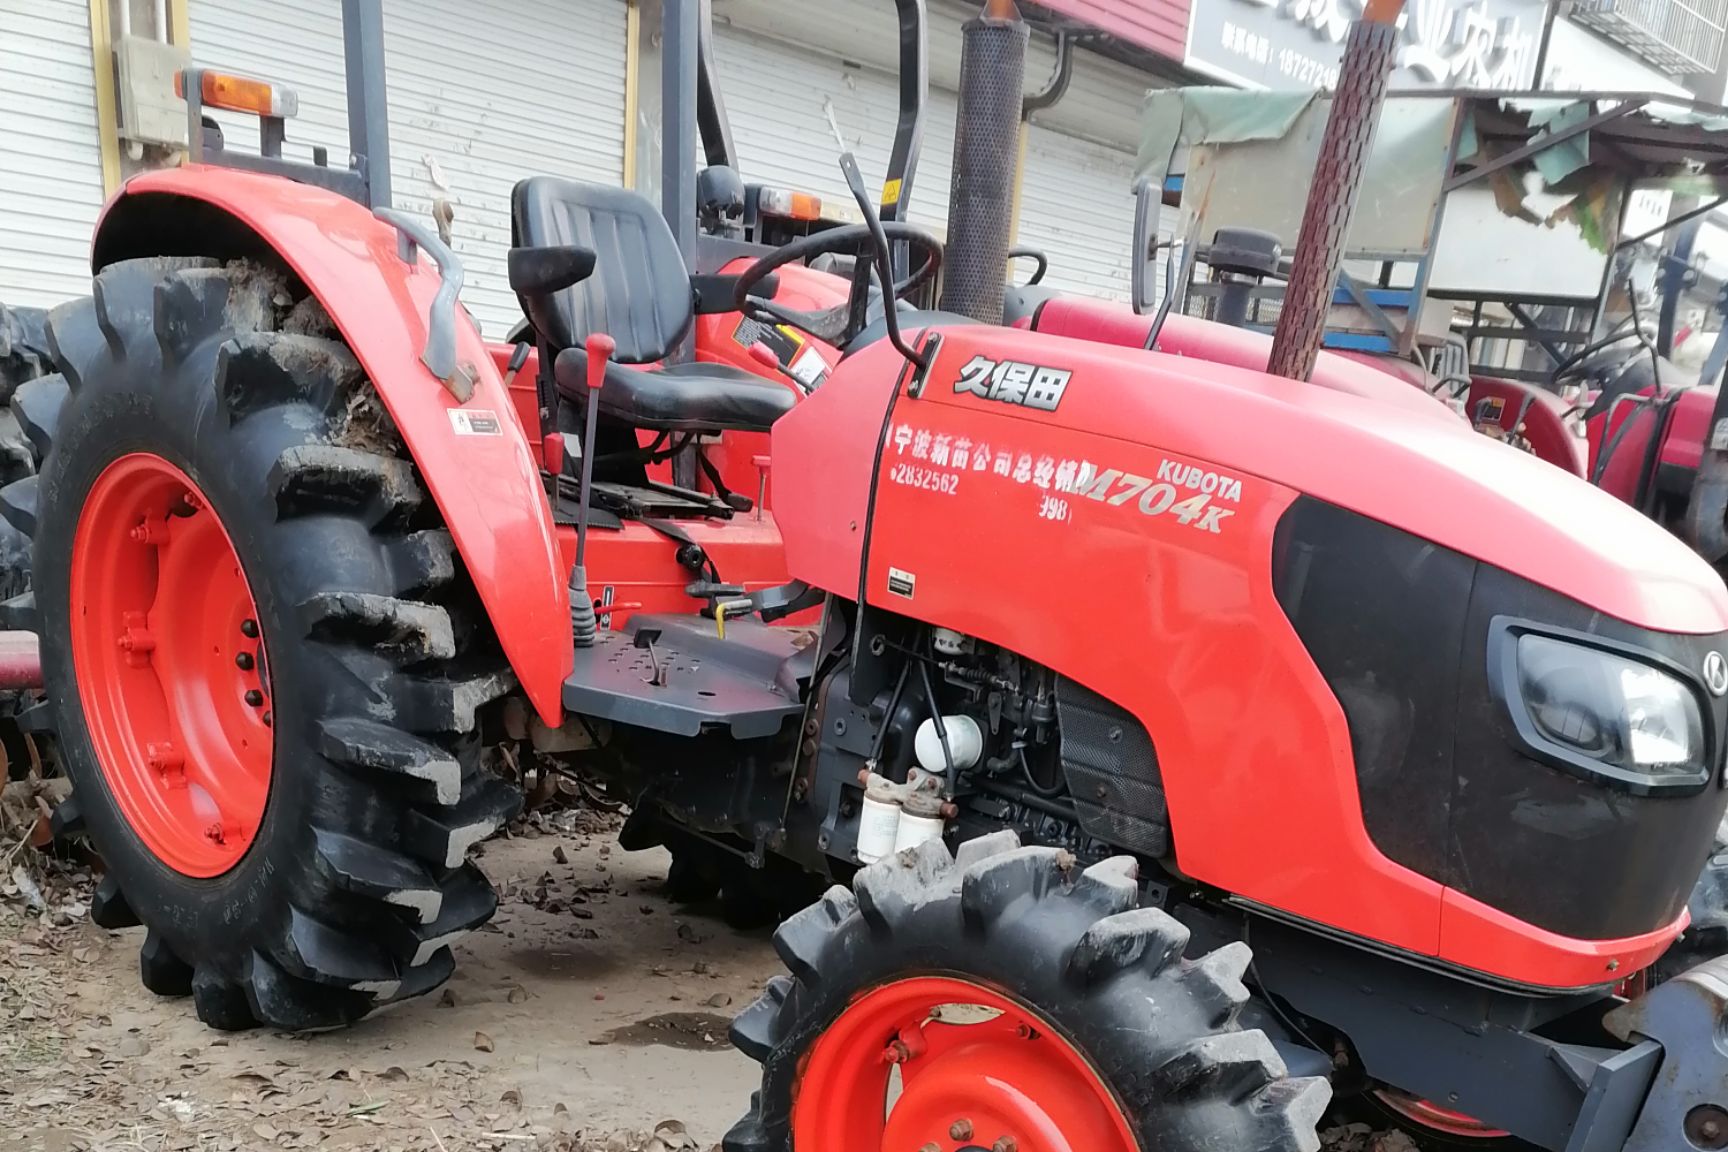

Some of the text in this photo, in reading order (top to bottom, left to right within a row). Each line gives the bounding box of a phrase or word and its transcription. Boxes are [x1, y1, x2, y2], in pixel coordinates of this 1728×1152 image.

[953, 355, 1073, 412] 久保田
[1157, 458, 1242, 503] KUBOTA
